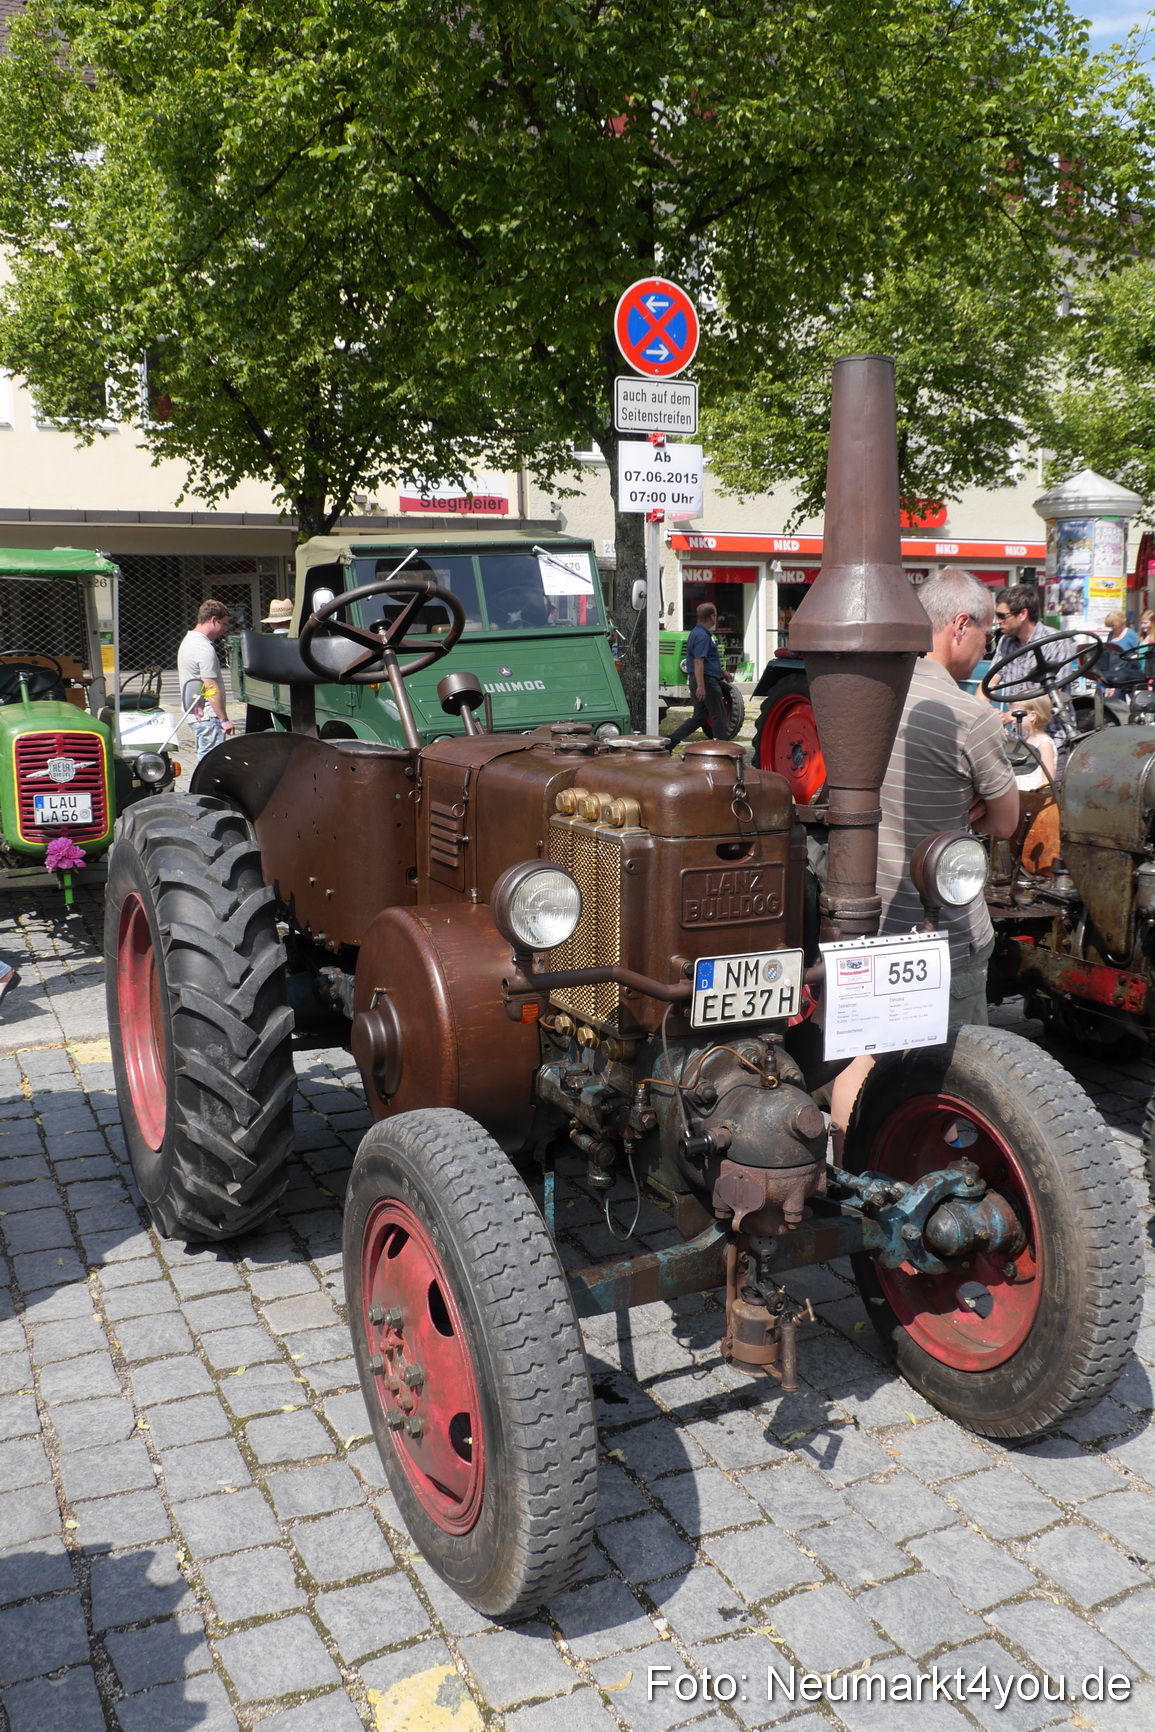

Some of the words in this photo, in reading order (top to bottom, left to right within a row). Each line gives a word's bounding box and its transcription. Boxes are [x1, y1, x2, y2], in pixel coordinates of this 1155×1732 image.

[623, 388, 647, 403] auch
[651, 390, 668, 404] auf
[670, 391, 691, 406] dem
[621, 406, 692, 425] Seitenstreifen
[654, 451, 672, 463] Ab
[624, 470, 698, 485] 07.06.2015
[420, 493, 504, 513] Stegmeier
[629, 491, 667, 504] 07:00
[671, 492, 694, 504] Uhr
[689, 537, 717, 549] NKD
[773, 539, 800, 551] NKD
[935, 543, 960, 555] NKD
[1004, 545, 1028, 556] NKD
[683, 568, 713, 582] NKD
[776, 570, 806, 583] NKD
[483, 680, 546, 693] UNIMOG
[49, 796, 77, 809] LAU
[706, 869, 764, 897] LANZ
[684, 892, 780, 923] BULLDOG
[725, 958, 760, 990] NM
[888, 958, 928, 985] 553
[701, 979, 709, 989] D
